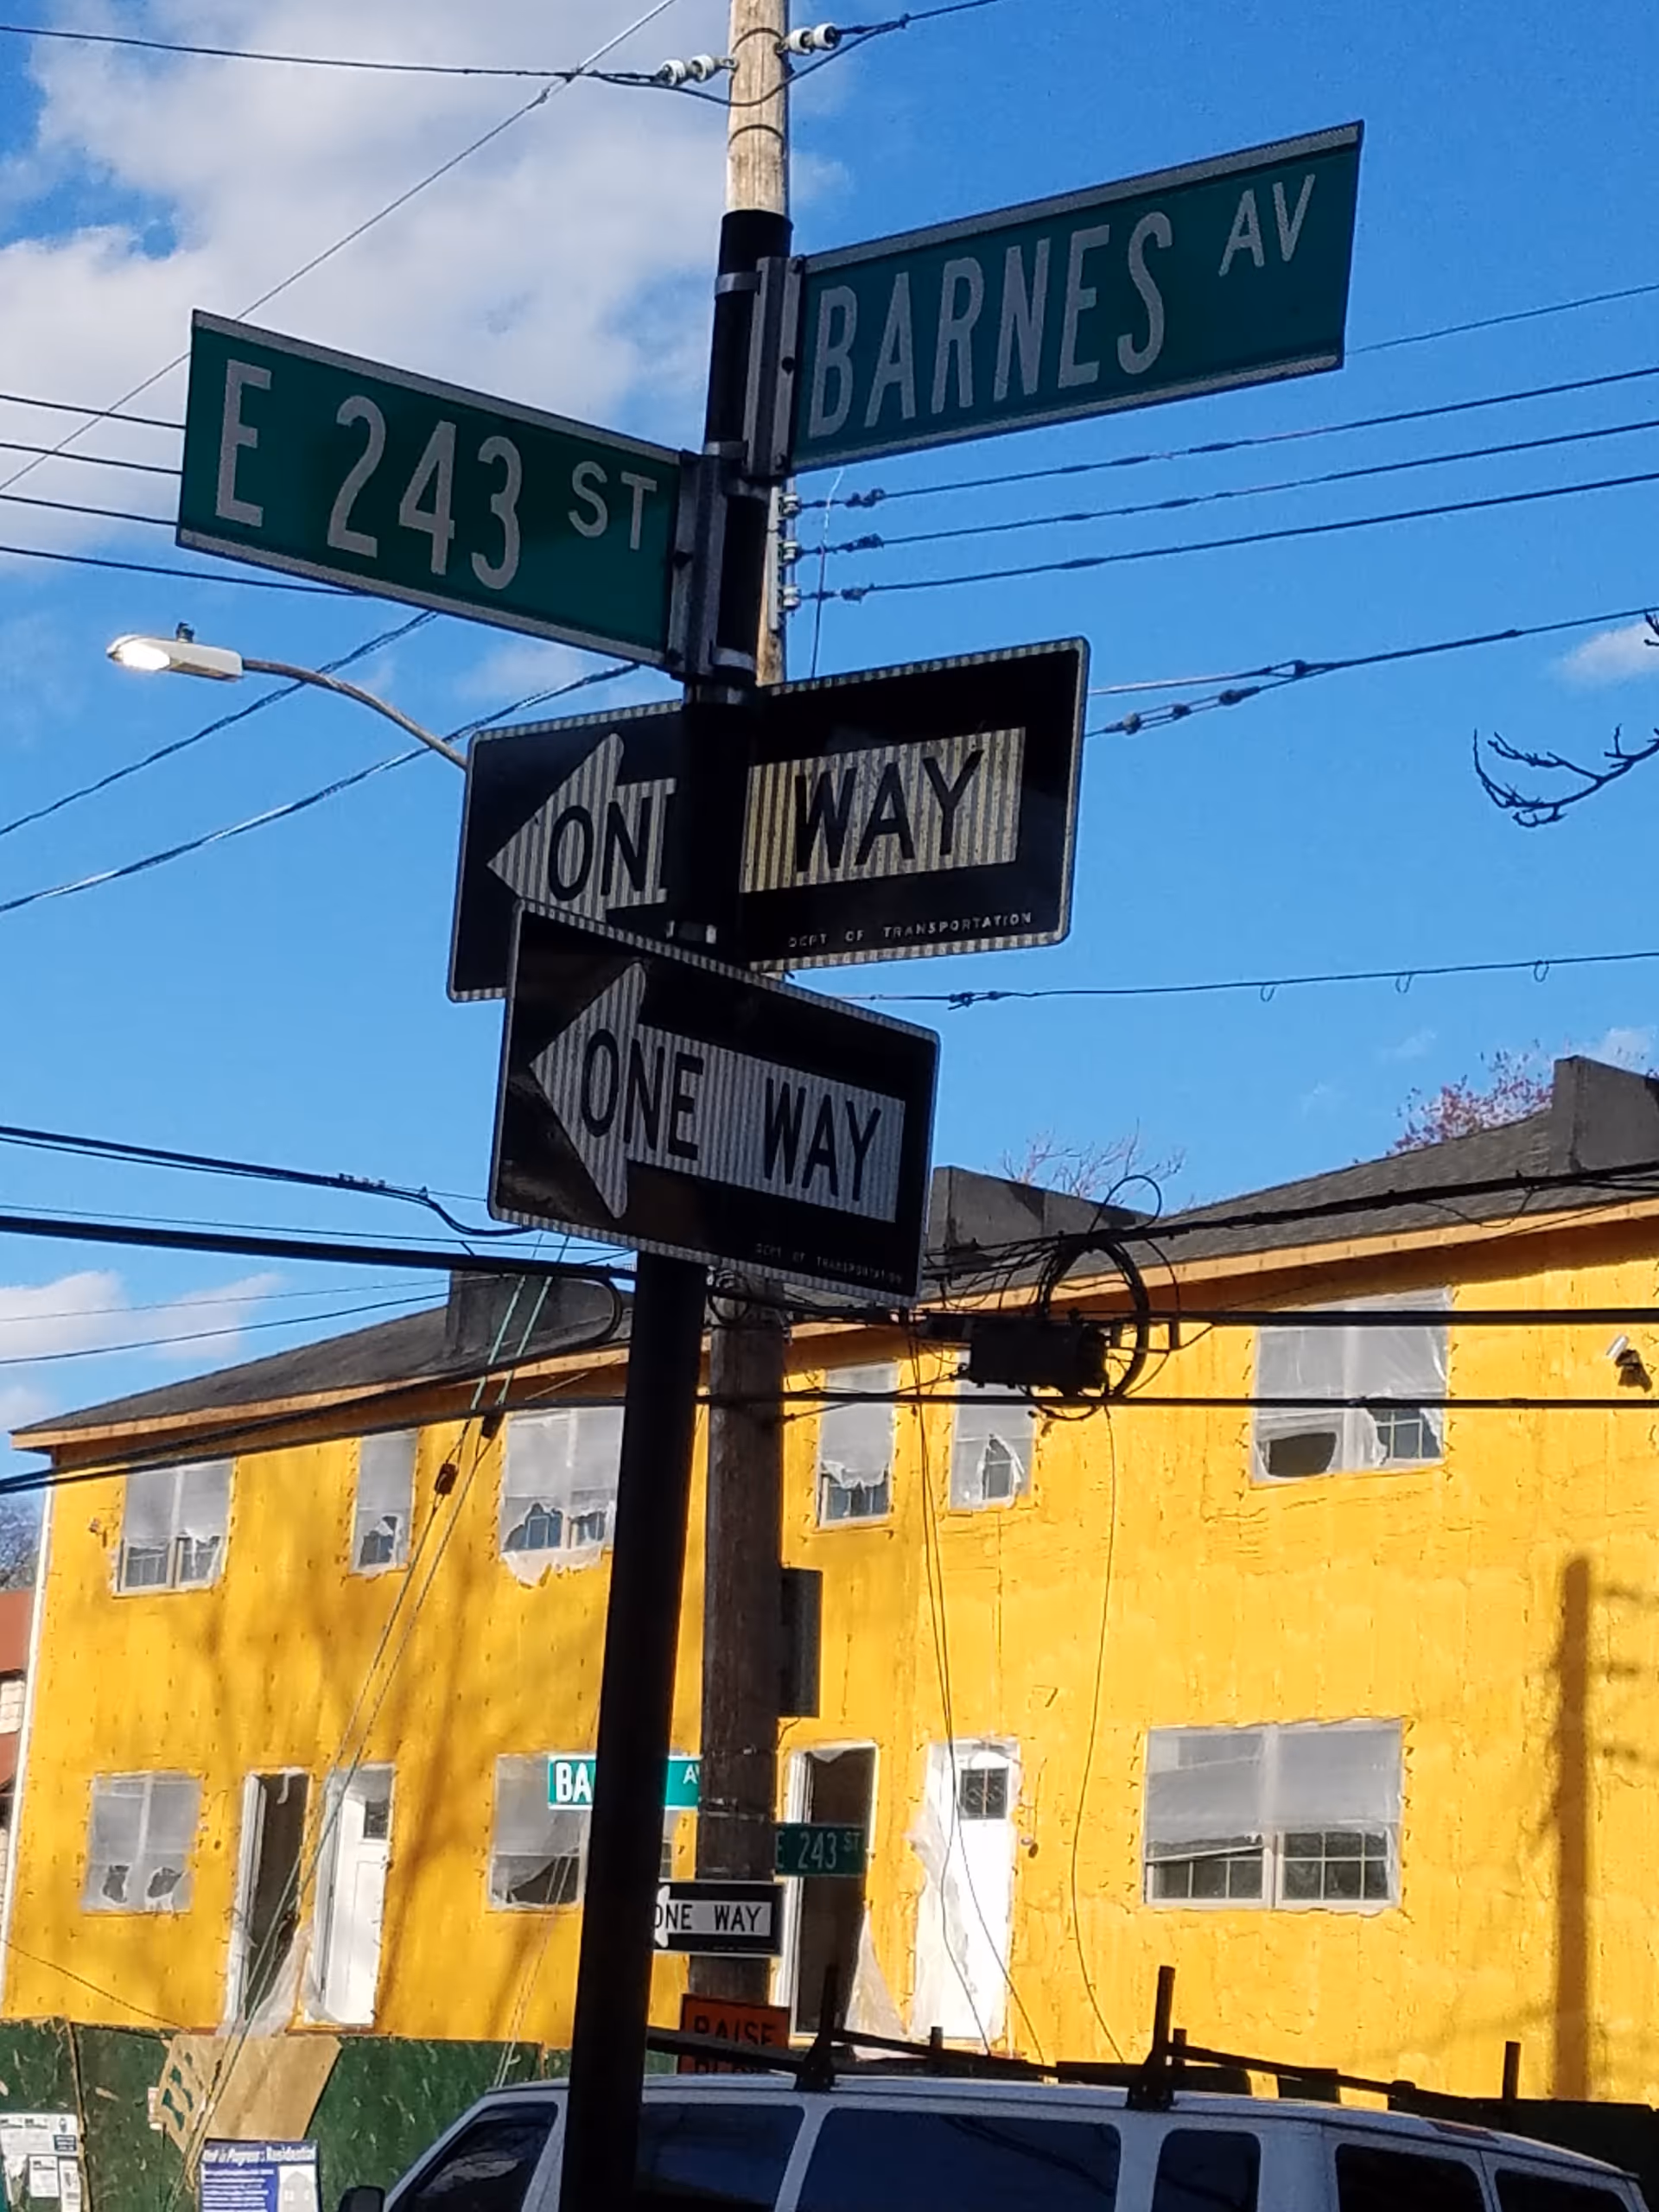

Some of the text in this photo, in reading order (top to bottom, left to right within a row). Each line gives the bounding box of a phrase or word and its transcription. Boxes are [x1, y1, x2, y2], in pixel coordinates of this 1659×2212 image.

[808, 174, 1315, 439] BARNES AV
[216, 359, 658, 590] E 243 ST
[794, 750, 985, 874] WAY
[883, 912, 1032, 938] TRANSPORTATION
[581, 1028, 881, 1202] ONE WAY
[775, 1830, 861, 1870] E 243 ST
[715, 1904, 762, 1933] WAY
